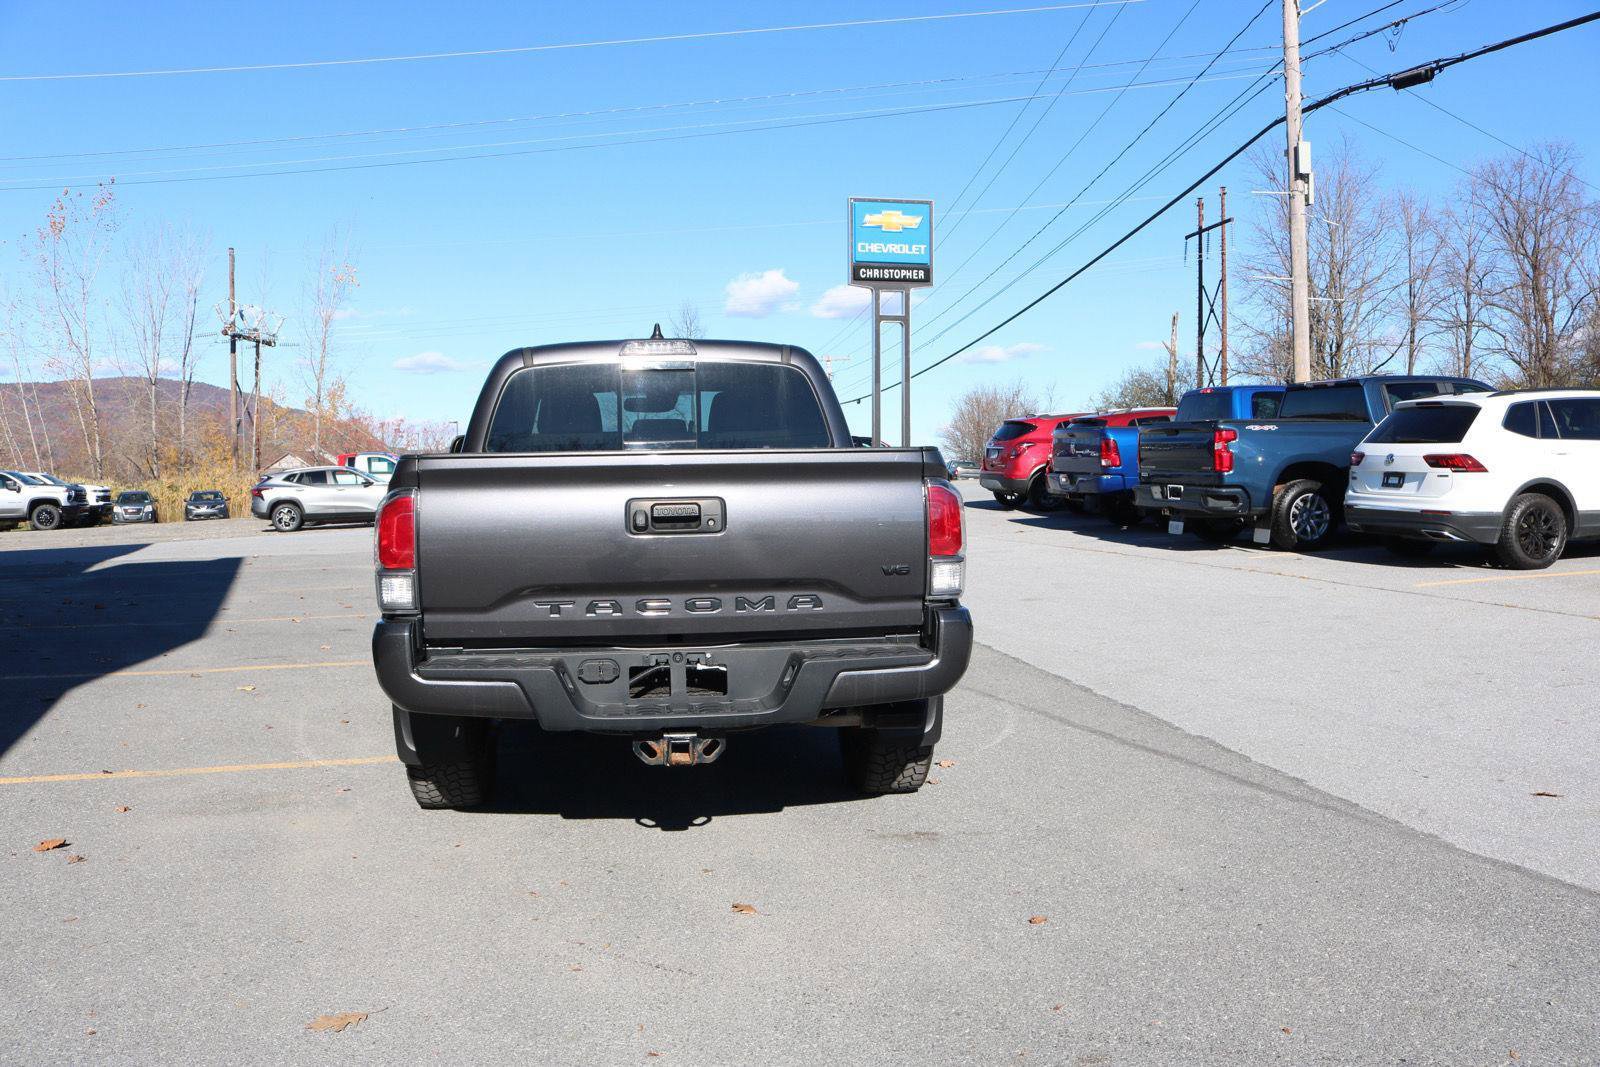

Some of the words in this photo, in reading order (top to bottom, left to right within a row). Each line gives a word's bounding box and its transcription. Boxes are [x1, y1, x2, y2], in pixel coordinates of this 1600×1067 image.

[858, 242, 927, 254] CHEVROLET
[860, 268, 924, 279] CHRISTOPHER
[655, 507, 698, 517] TOYOTA
[533, 593, 824, 618] TACOMA
